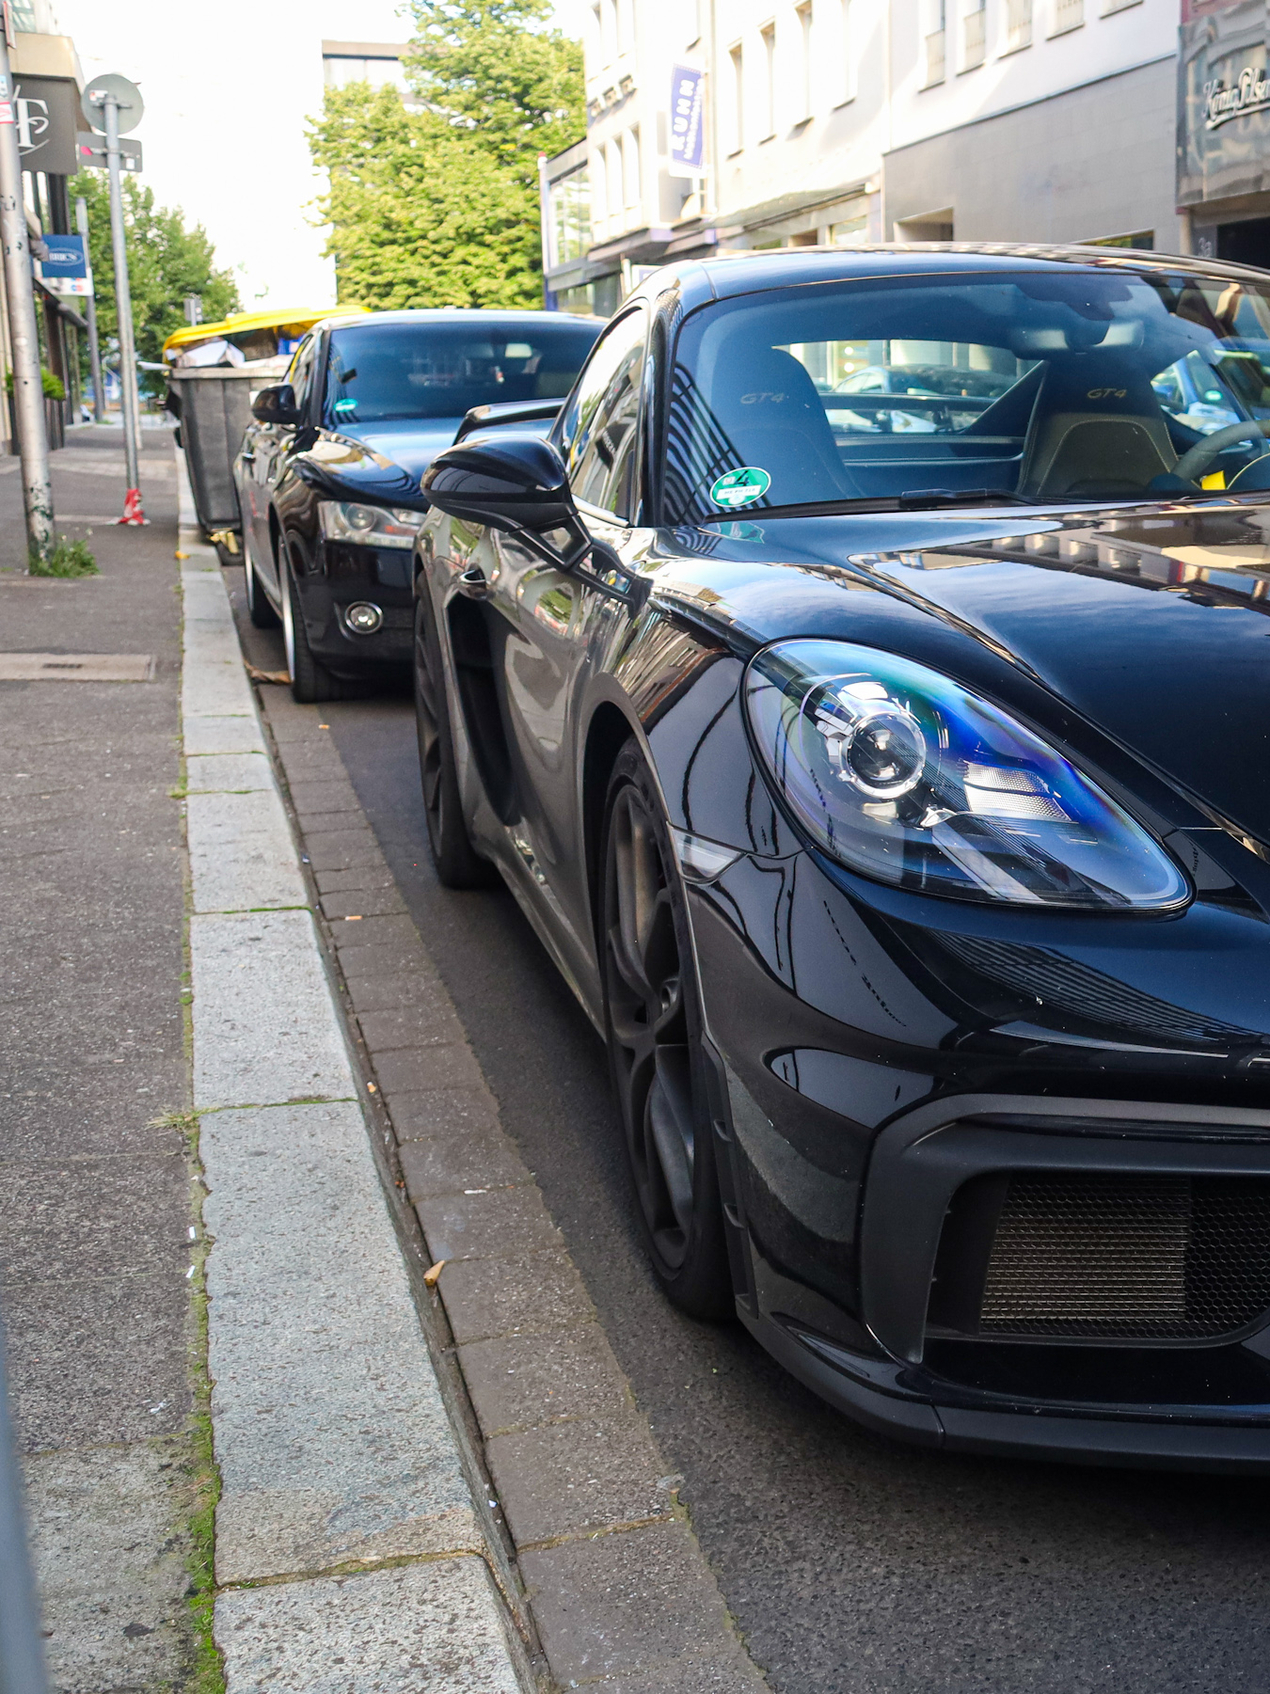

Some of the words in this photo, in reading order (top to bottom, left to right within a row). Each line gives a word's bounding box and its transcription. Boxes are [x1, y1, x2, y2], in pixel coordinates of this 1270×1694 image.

[740, 392, 785, 404] GT4
[1087, 387, 1128, 399] GT4
[733, 470, 750, 486] 4
